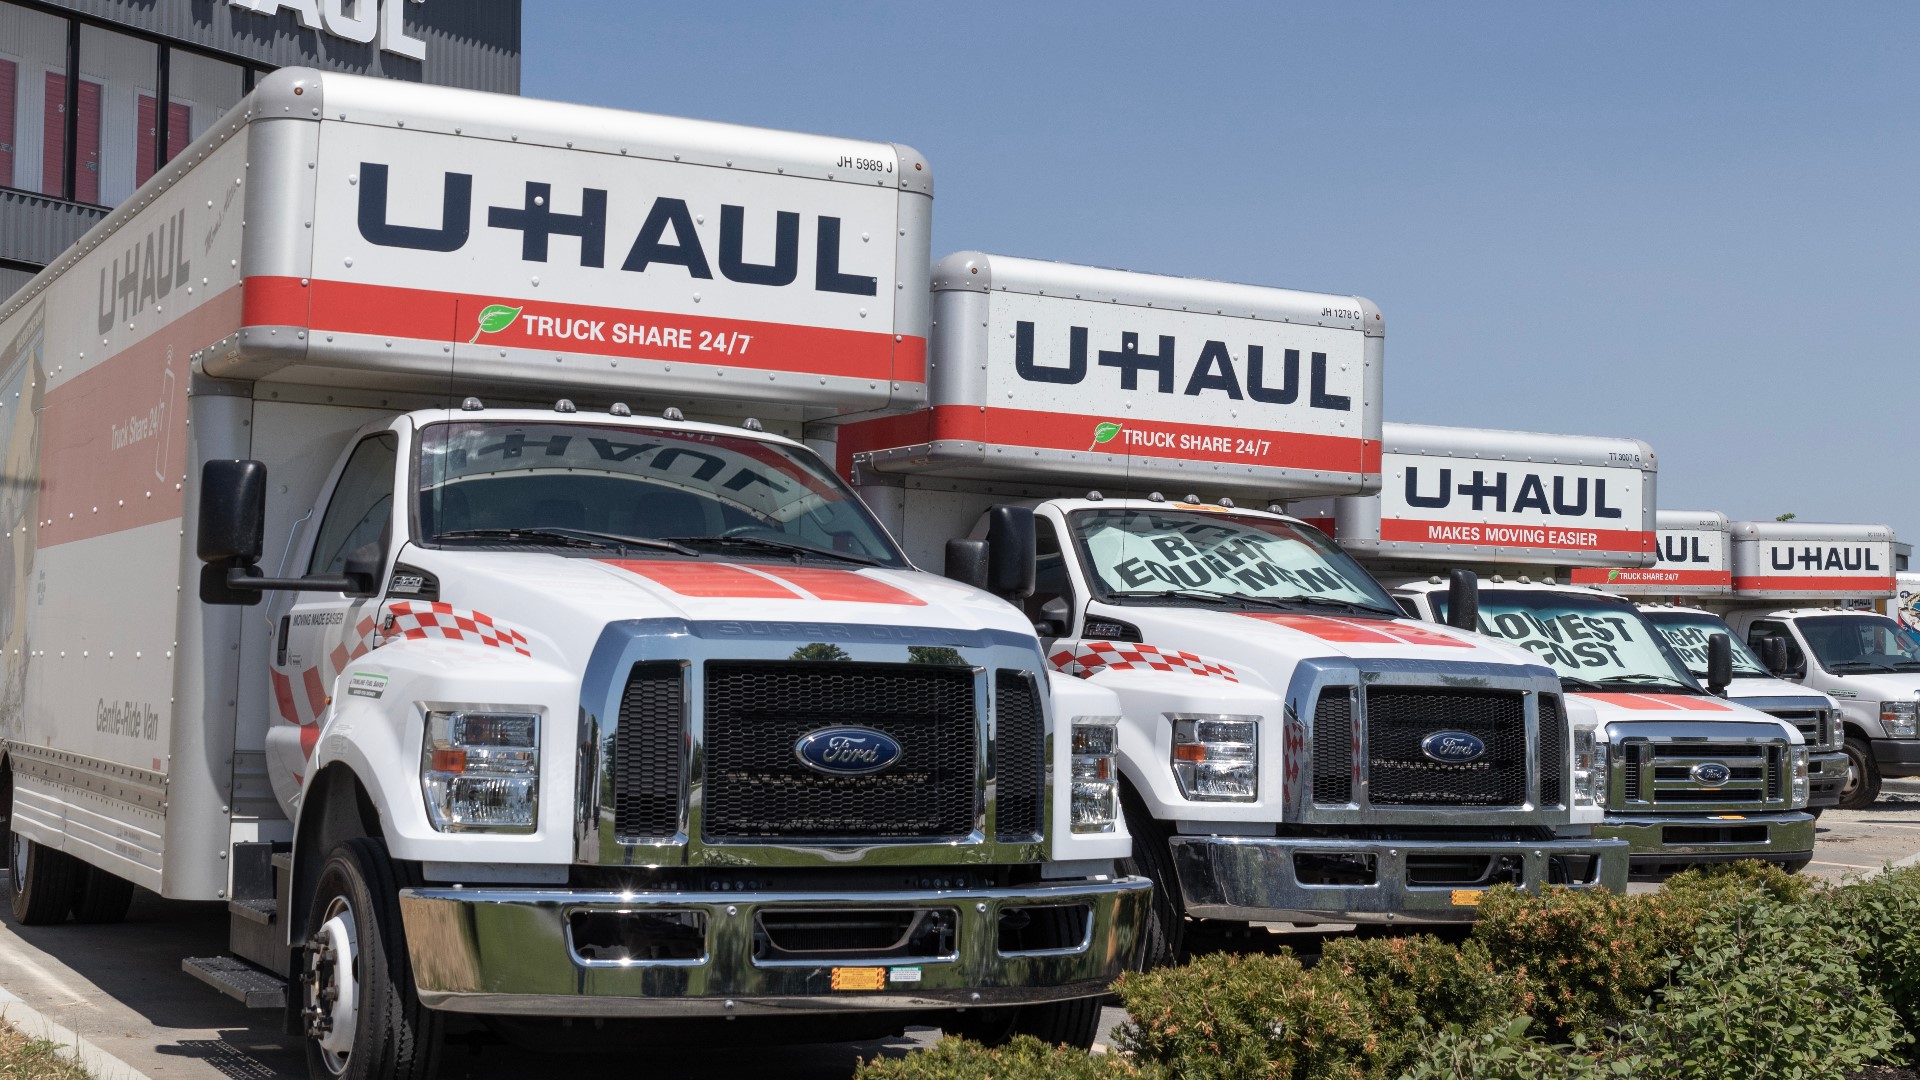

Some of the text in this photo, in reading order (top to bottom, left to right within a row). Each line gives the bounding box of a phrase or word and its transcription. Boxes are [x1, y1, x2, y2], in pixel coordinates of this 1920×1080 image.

[837, 156, 893, 173] JH 5989 J
[357, 161, 877, 297] U-HAUL
[98, 208, 190, 335] U-HAUL
[1321, 308, 1332, 317] JH
[522, 314, 751, 355] TRUCK SHARE 24/7
[1015, 321, 1352, 411] U-HAUL
[111, 402, 165, 450] Truck Share 24/7
[1122, 429, 1272, 456] TRUCK SHARE 24/7
[1405, 466, 1622, 519] U-HAUL
[1428, 525, 1598, 546] MAKES MOVING EASIER
[1772, 547, 1879, 570] U-HAUL
[1619, 572, 1641, 580] TRUCK
[293, 612, 344, 627] MOVING MADE EASIER
[1476, 610, 1634, 643] LOWEST
[1660, 627, 1709, 647] IGHT
[1519, 640, 1626, 669] COST
[97, 698, 158, 741] Gentle-Ride Van
[823, 736, 880, 763] Ford
[1440, 737, 1473, 755] Ford
